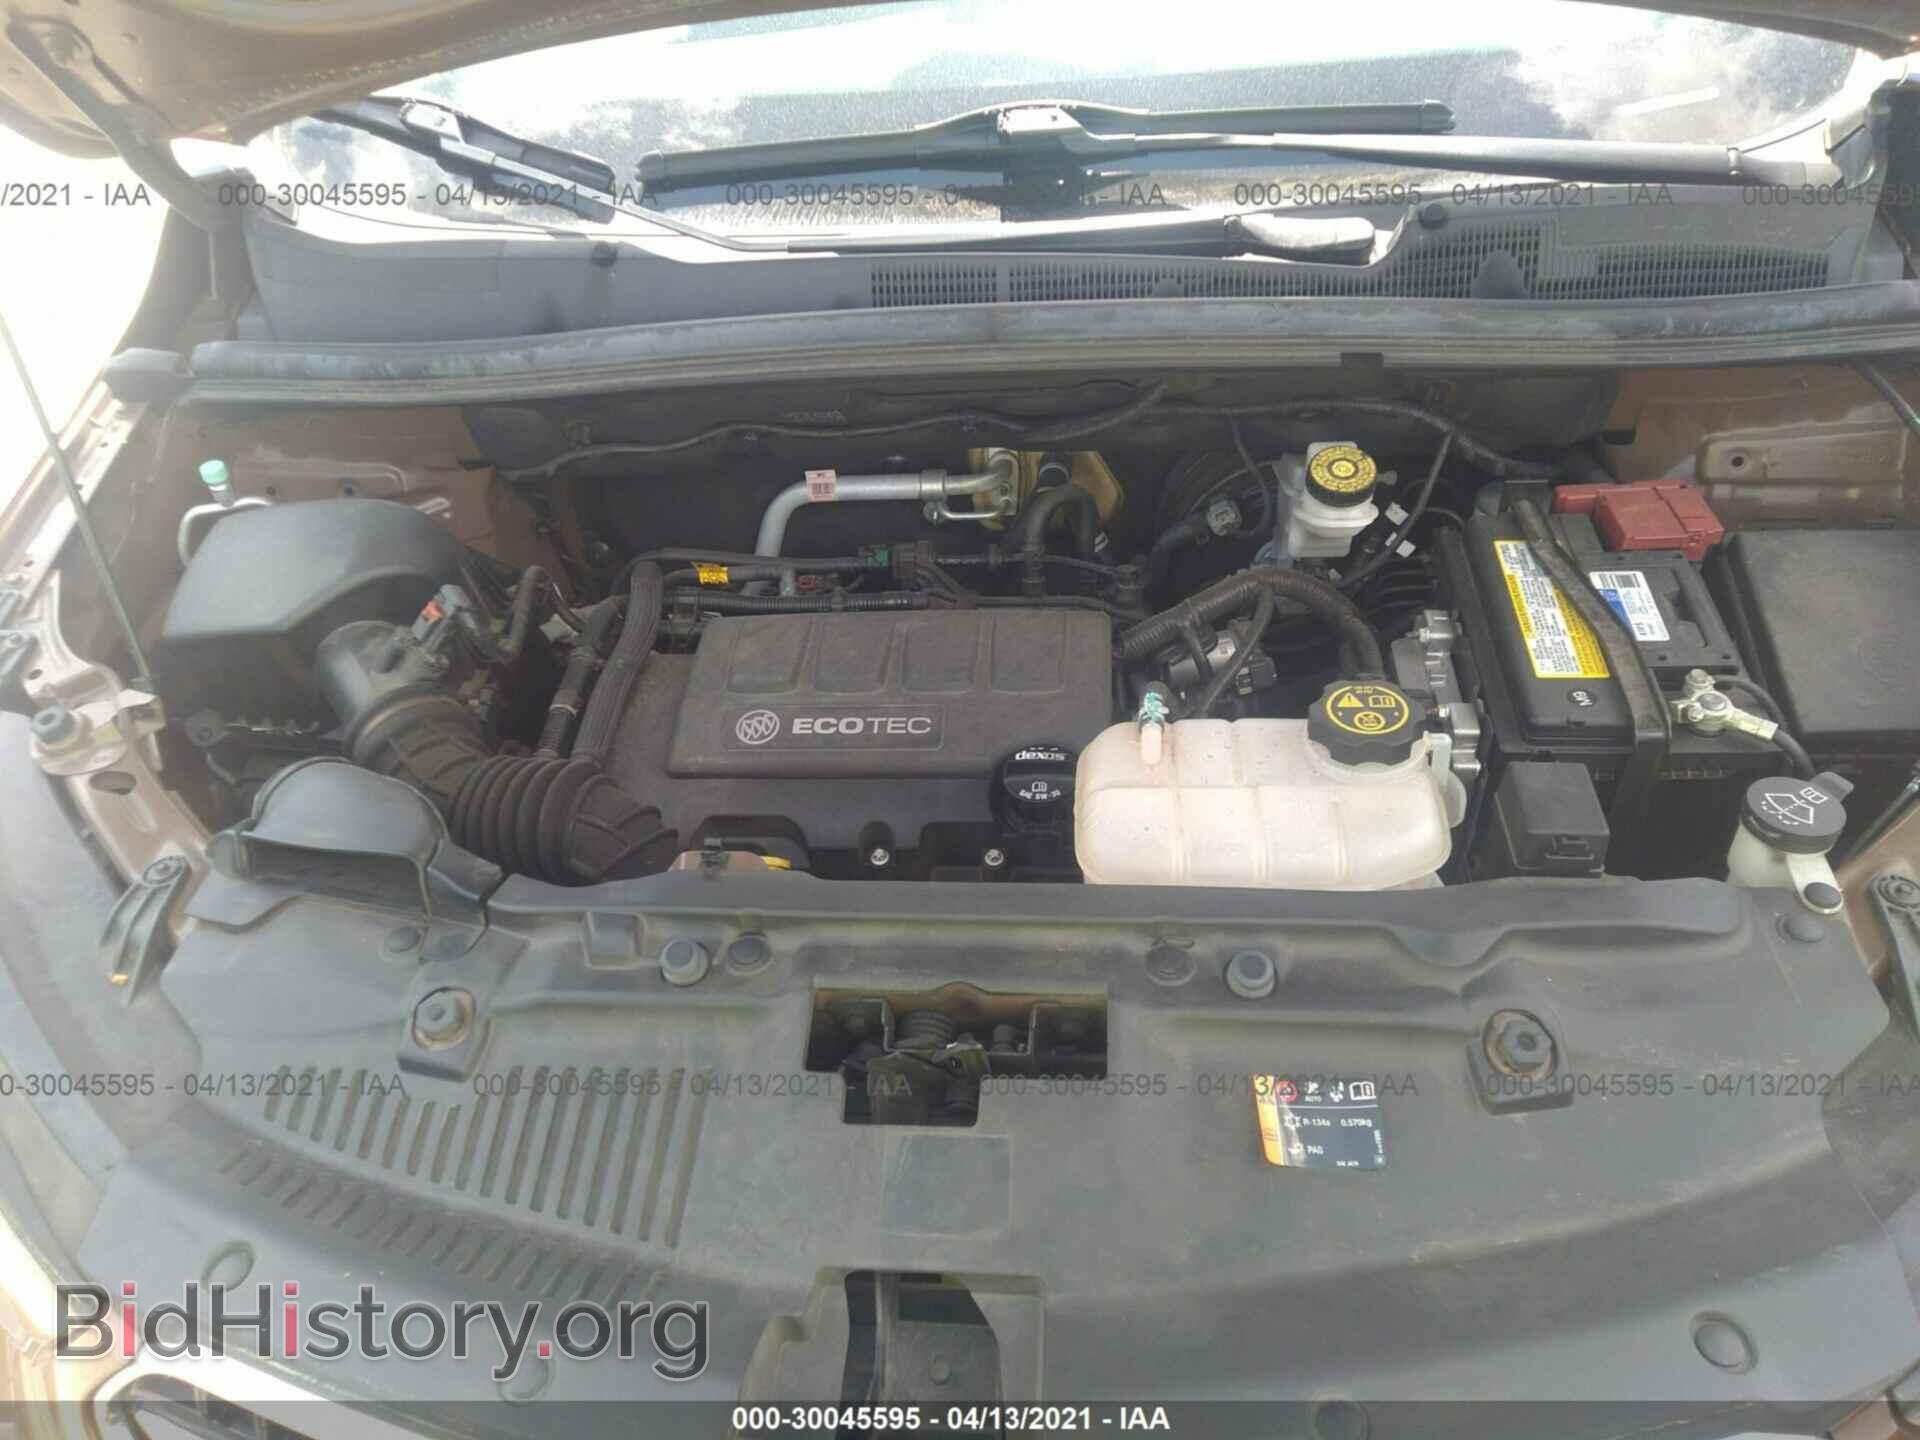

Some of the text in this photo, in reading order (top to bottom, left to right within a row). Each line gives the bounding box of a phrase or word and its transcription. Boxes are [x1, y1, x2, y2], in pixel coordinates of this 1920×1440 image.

[792, 717, 932, 734] ECOTEC
[1015, 750, 1067, 761] dexos
[1307, 1144, 1324, 1155] PAG
